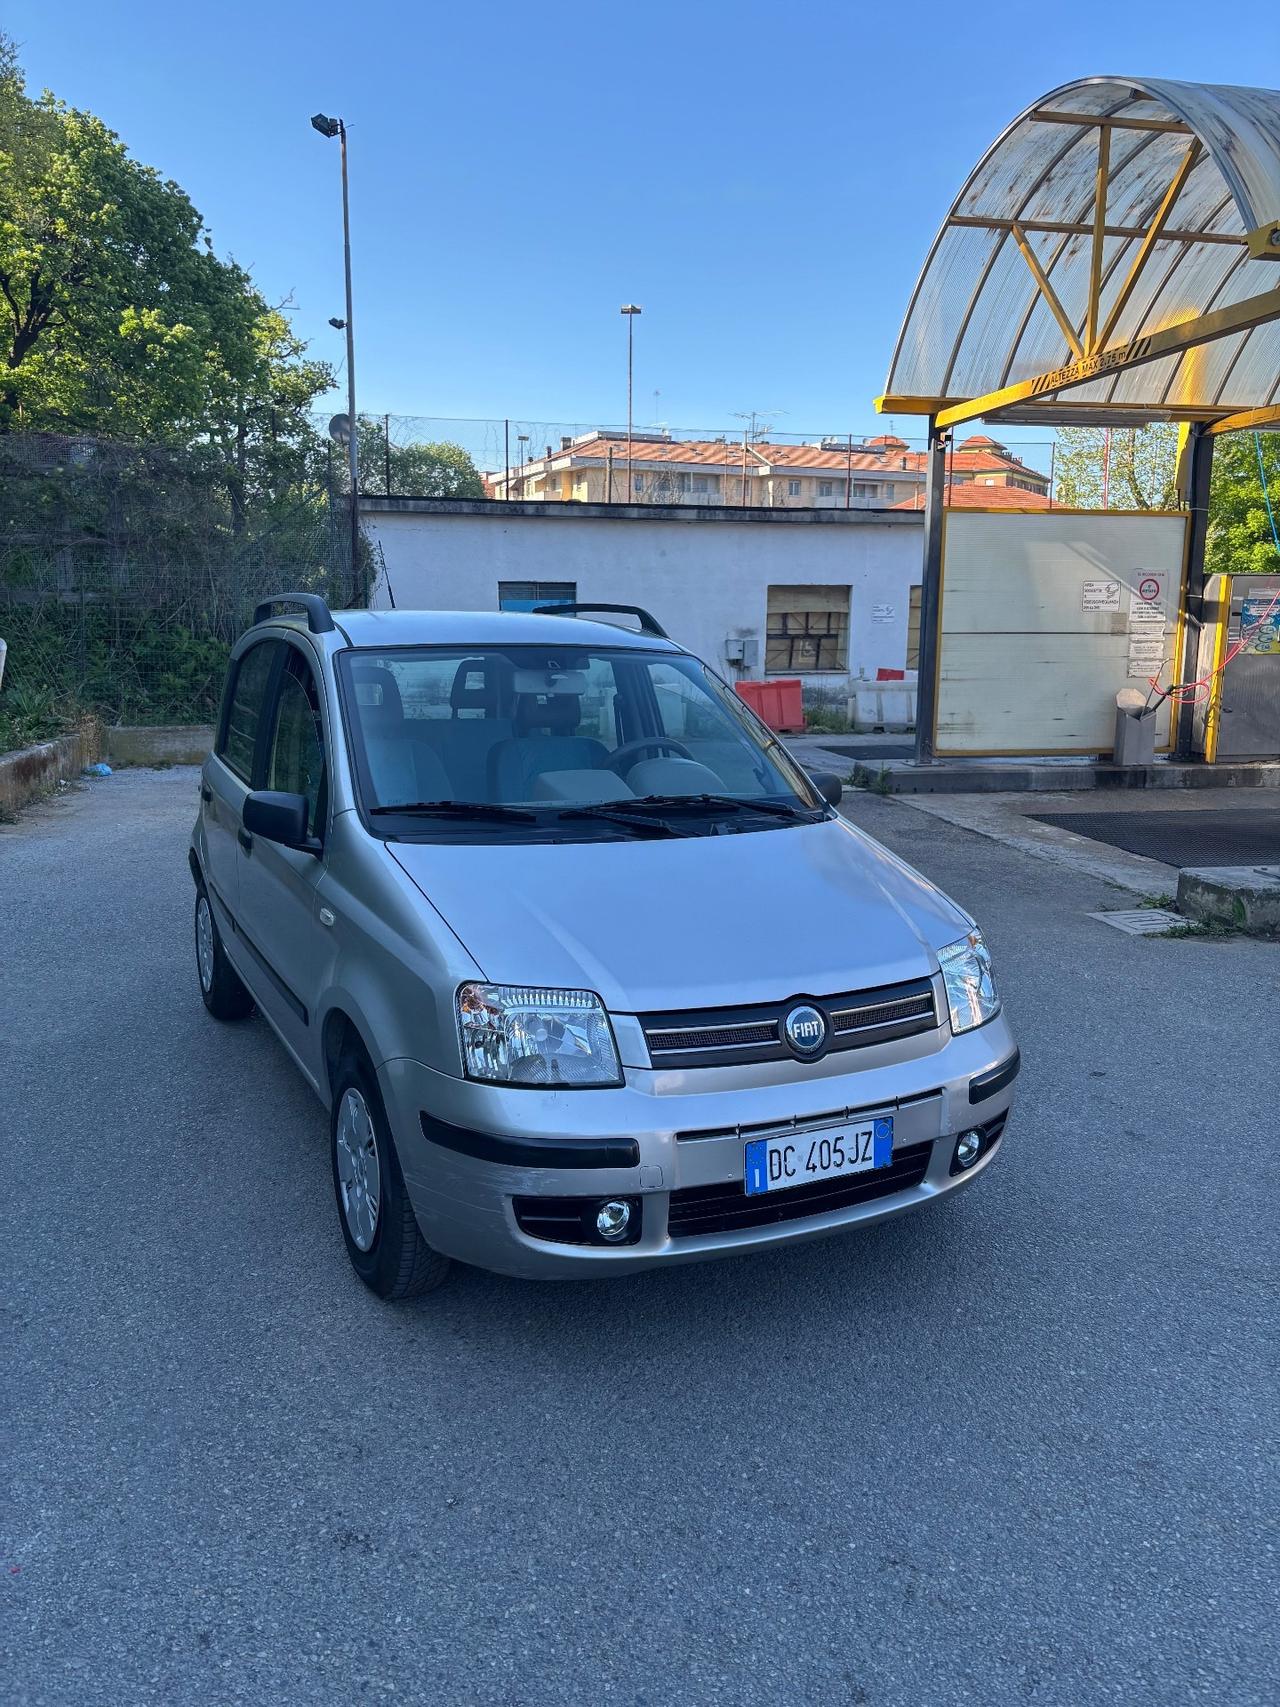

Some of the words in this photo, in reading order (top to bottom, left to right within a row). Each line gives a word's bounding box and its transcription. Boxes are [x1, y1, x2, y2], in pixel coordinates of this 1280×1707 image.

[1050, 367, 1079, 382] ALTEZZA
[1082, 360, 1098, 371] MAX
[793, 1021, 819, 1038] FIAT
[769, 1145, 796, 1181] DC
